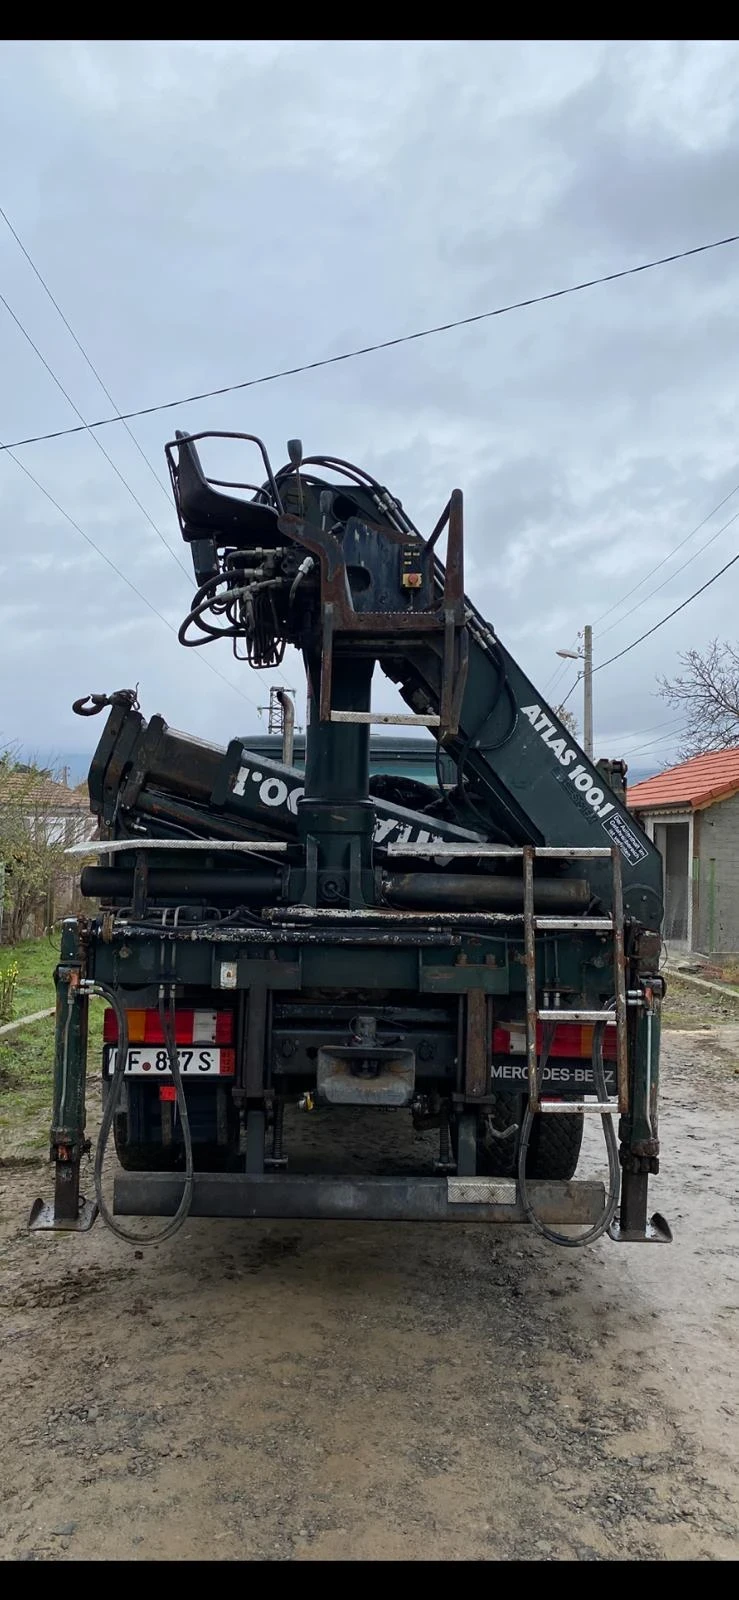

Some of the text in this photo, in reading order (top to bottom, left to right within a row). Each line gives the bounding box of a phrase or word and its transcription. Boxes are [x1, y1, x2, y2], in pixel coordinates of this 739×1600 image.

[520, 704, 578, 766] ATLAS
[567, 764, 616, 818] 100.1
[613, 815, 622, 826] Der
[198, 1051, 211, 1072] S
[490, 1065, 615, 1083] MERCDES-BEZ
